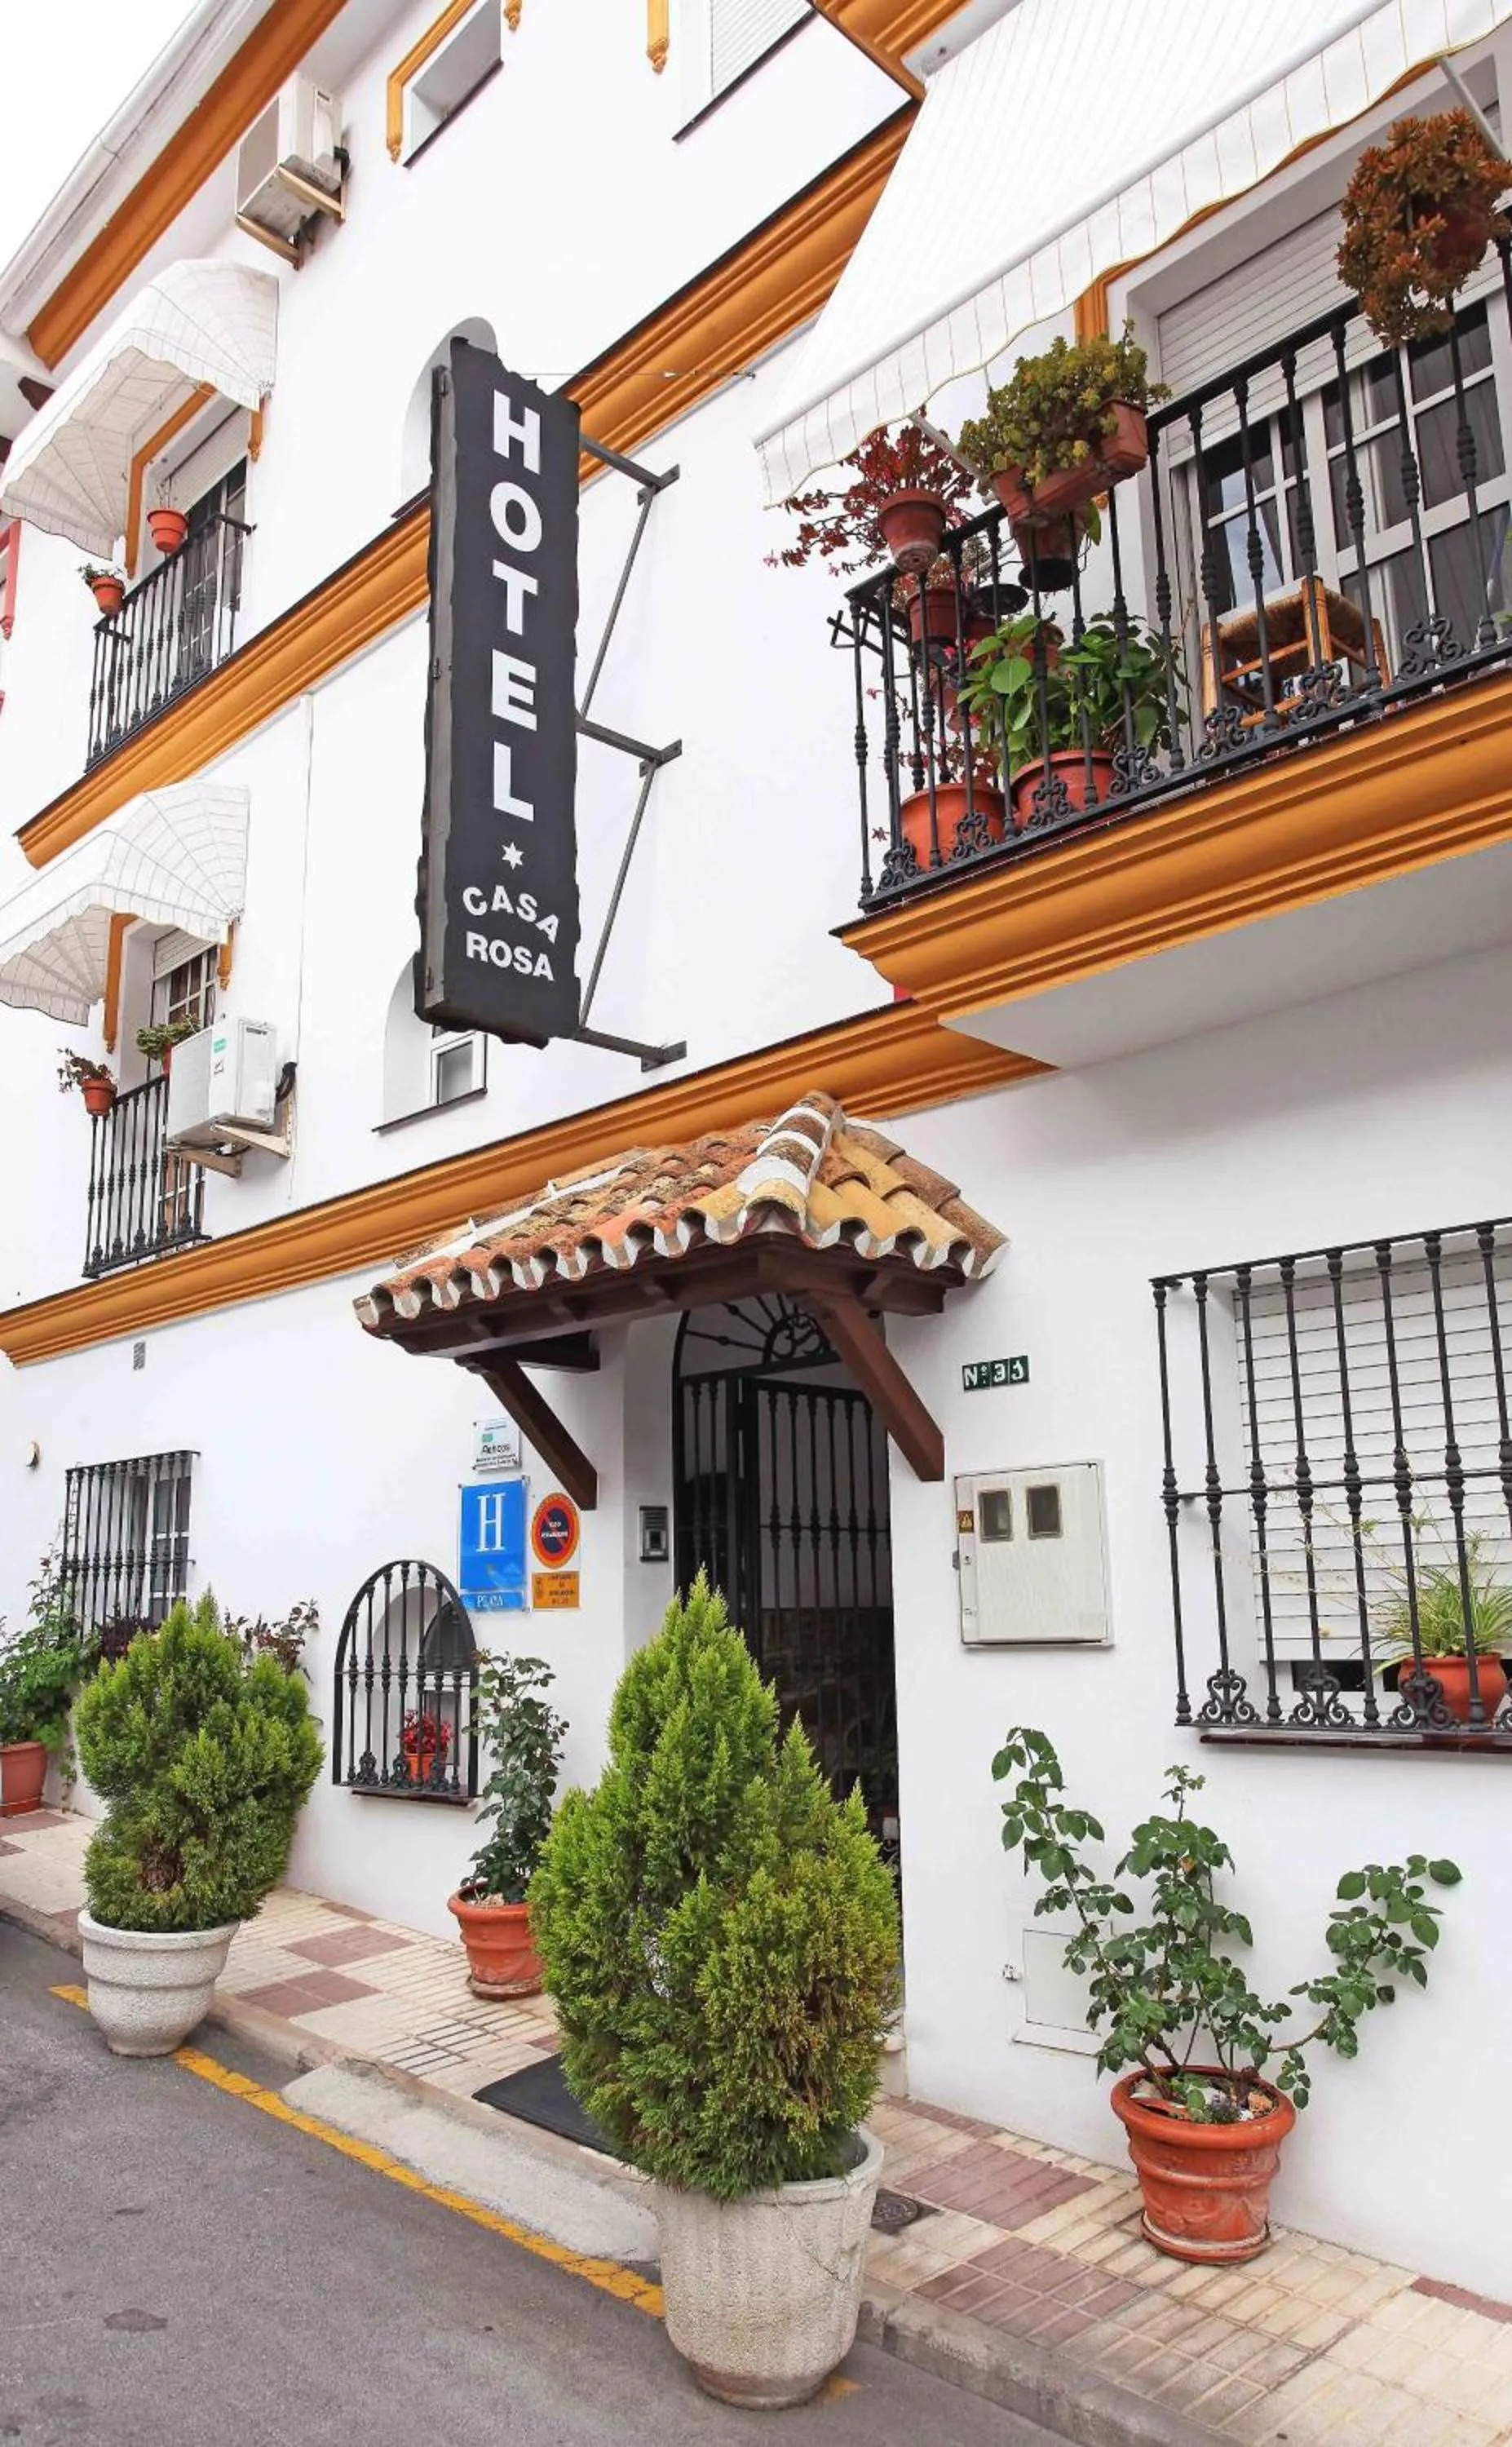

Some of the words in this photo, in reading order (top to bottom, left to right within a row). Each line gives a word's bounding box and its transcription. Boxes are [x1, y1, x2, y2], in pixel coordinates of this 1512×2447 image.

[490, 388, 542, 822] HOTEL
[462, 883, 559, 945] CASA
[466, 931, 555, 981] ROSA
[475, 1492, 506, 1552] H
